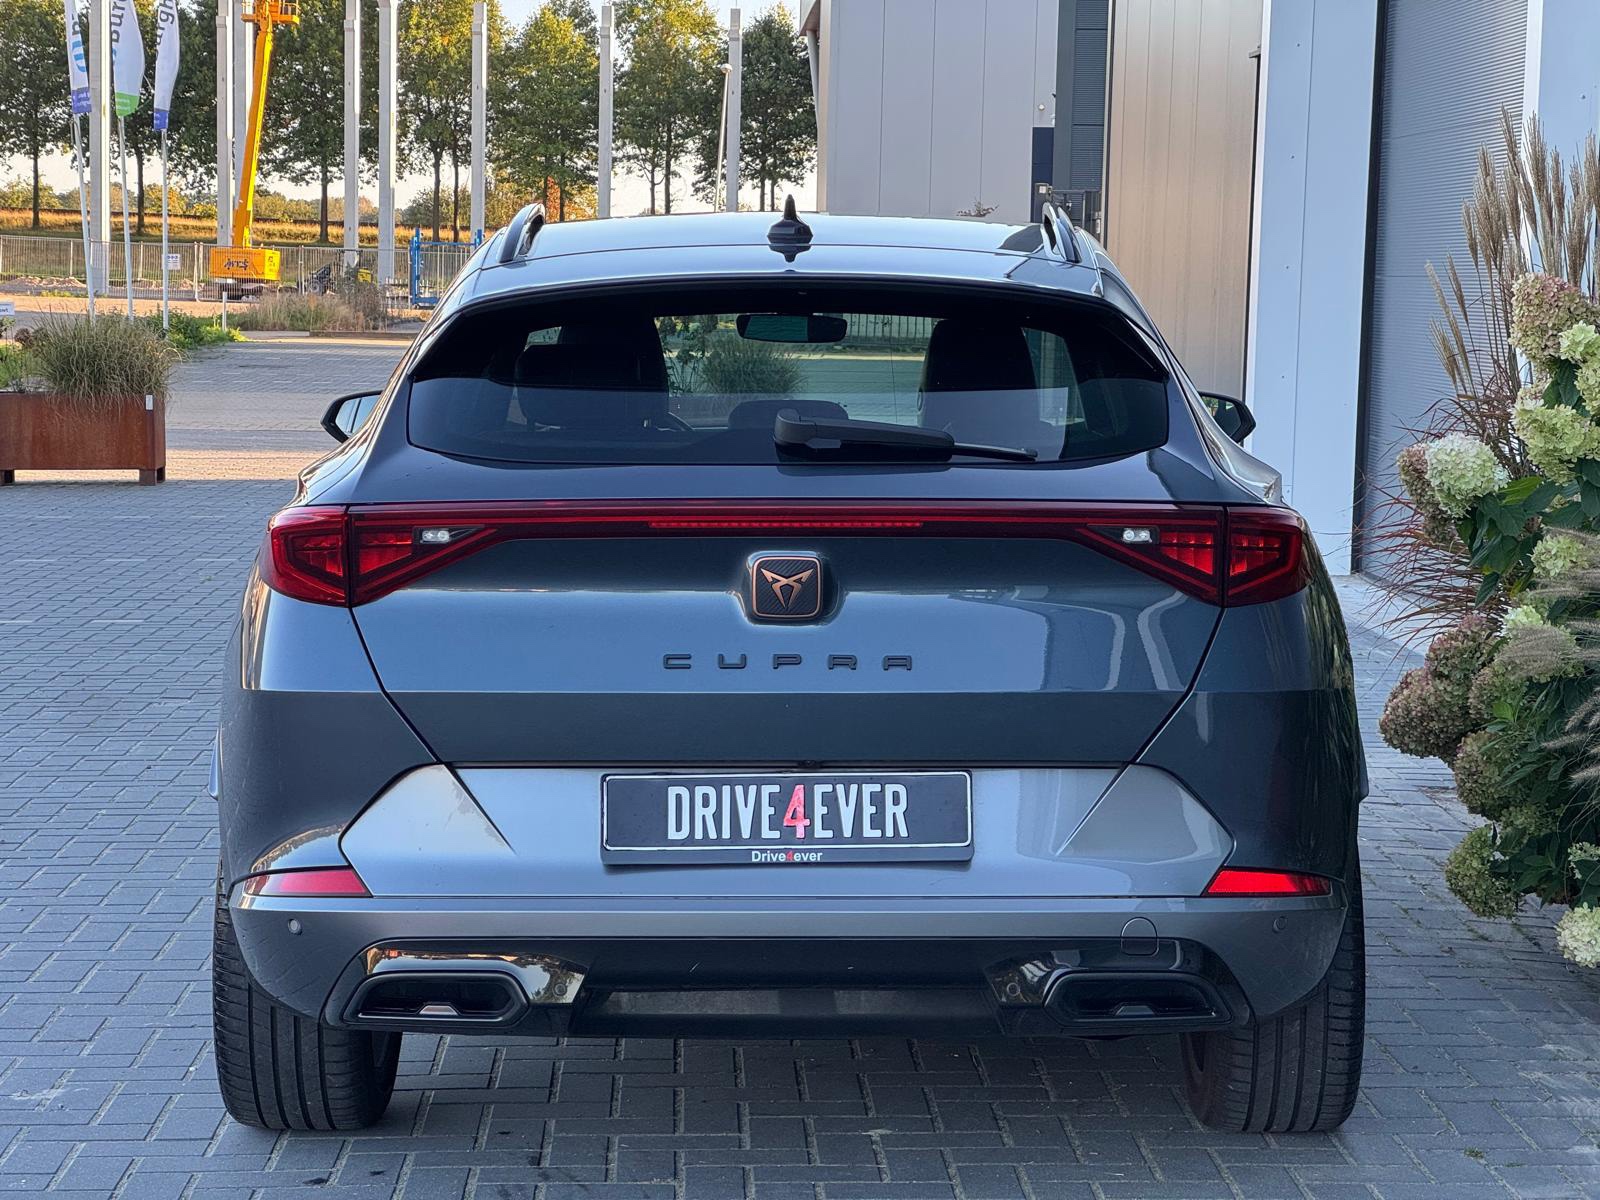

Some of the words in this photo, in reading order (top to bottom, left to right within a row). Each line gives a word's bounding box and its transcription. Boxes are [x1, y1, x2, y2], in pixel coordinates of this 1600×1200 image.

[663, 653, 912, 670] CUPRA
[667, 783, 909, 840] DRIVE4EVER
[751, 850, 823, 863] Drive4ever
